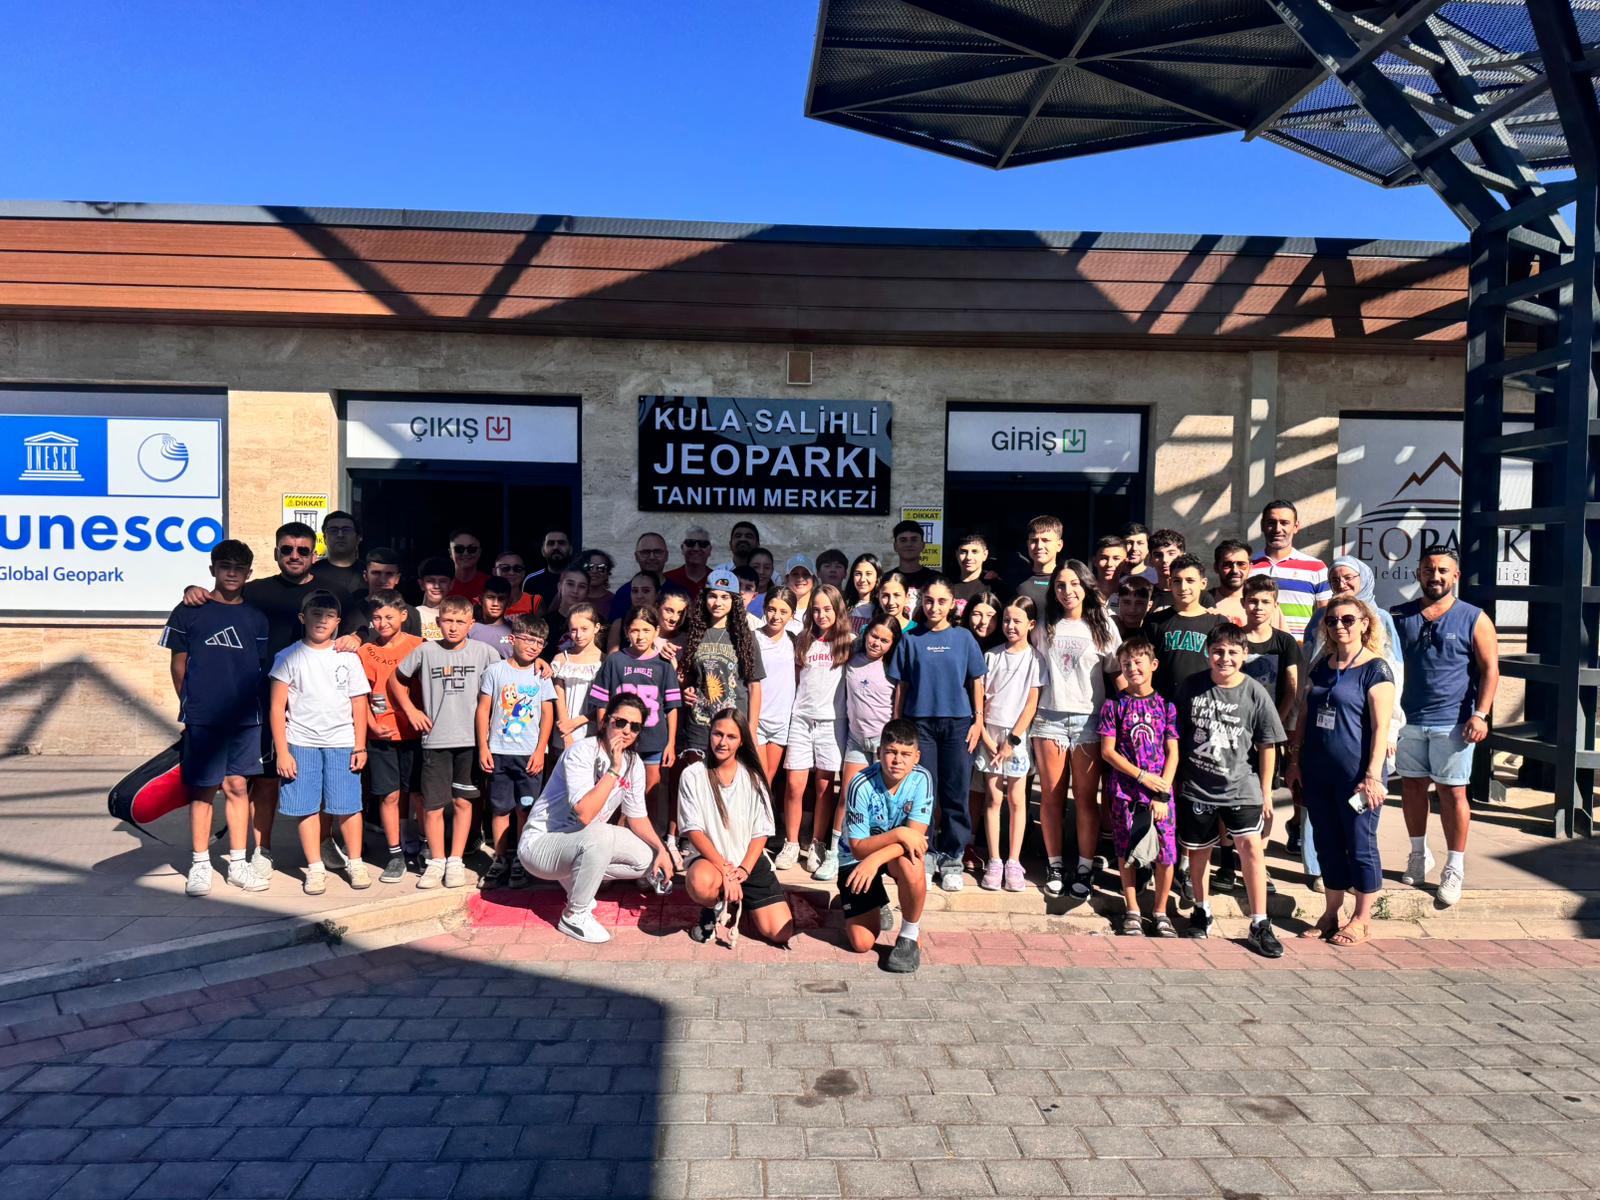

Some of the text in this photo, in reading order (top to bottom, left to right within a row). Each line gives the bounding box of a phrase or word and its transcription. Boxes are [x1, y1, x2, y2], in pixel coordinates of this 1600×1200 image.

[410, 416, 479, 444] ÇIKIŞ
[991, 426, 1057, 456] GİRİŞ
[27, 445, 76, 470] UNESCO
[653, 443, 876, 478] JEOPARKI
[653, 486, 876, 509] TANITIM MERKEZİ
[0, 514, 223, 552] unesco
[0, 566, 124, 585] Global Geopark
[1165, 630, 1209, 658] MAV
